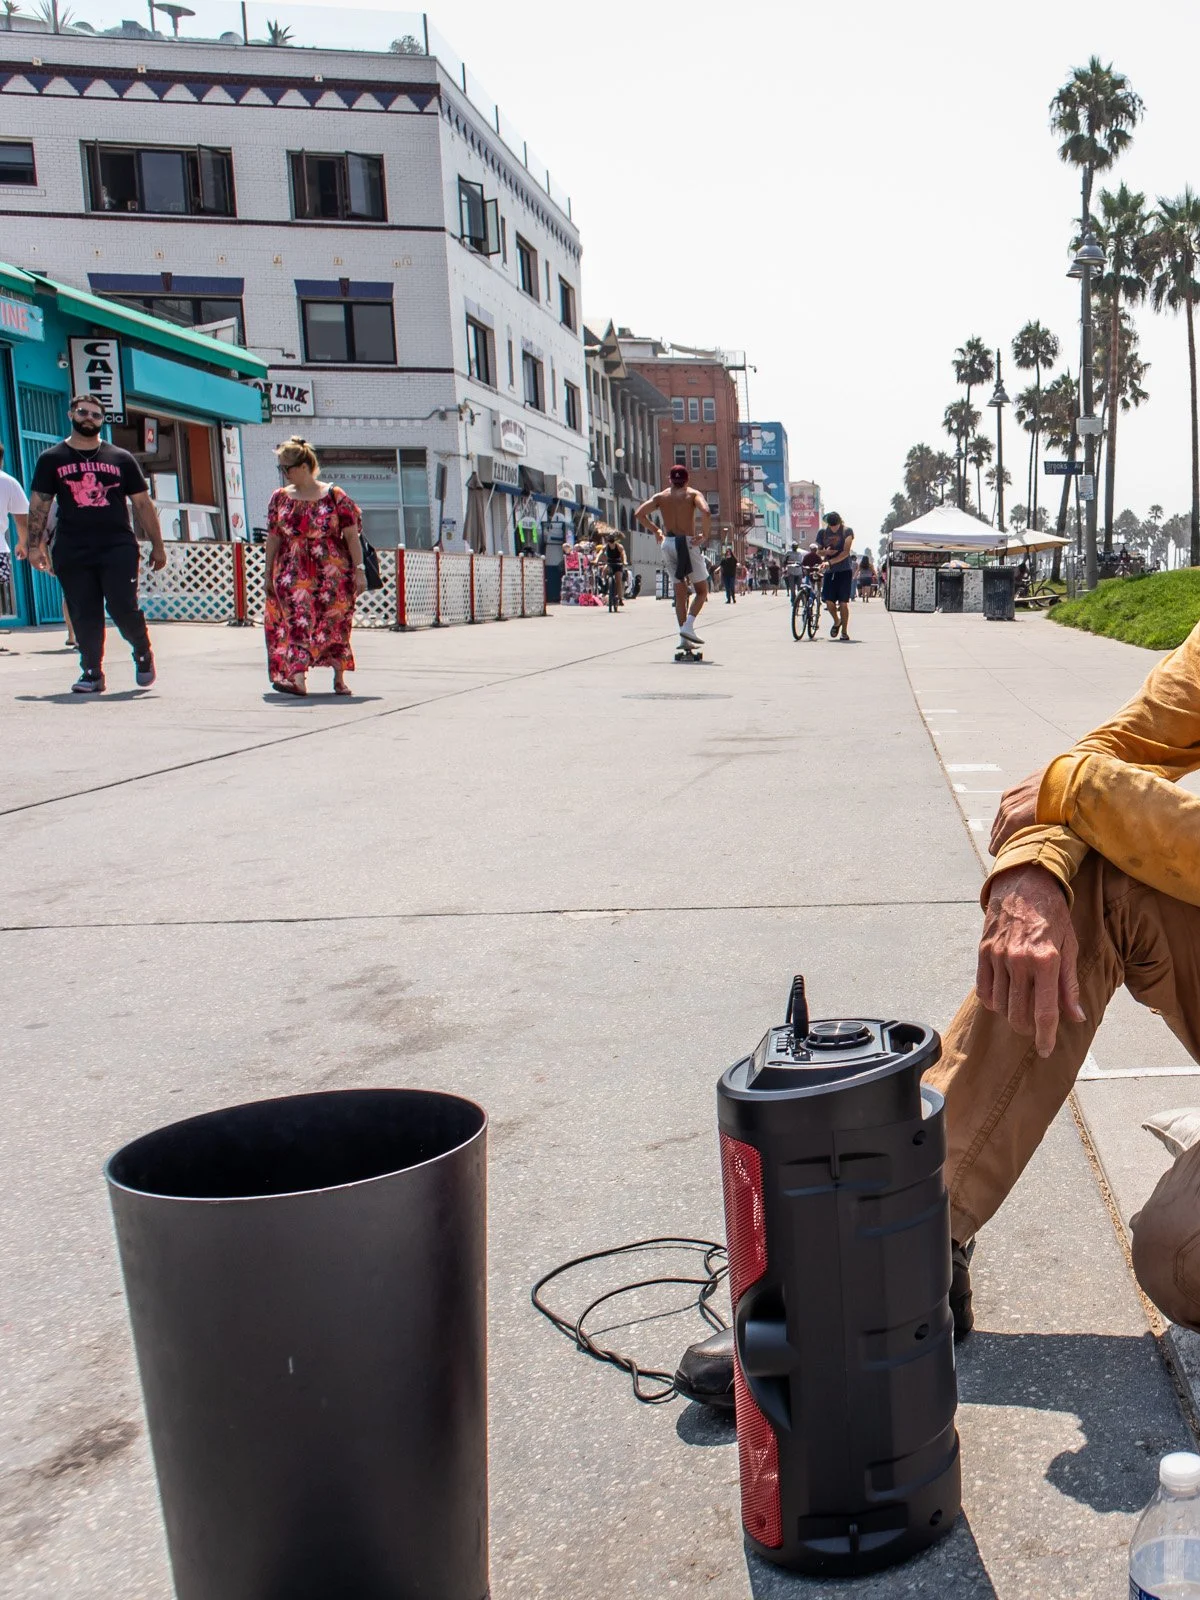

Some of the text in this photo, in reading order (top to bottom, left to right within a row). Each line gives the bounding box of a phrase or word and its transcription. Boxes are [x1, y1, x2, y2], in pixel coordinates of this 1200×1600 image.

[83, 342, 114, 408] CAFE
[275, 383, 309, 404] INK
[752, 448, 776, 456] WORLD
[57, 462, 121, 478] TRUE RELIGION
